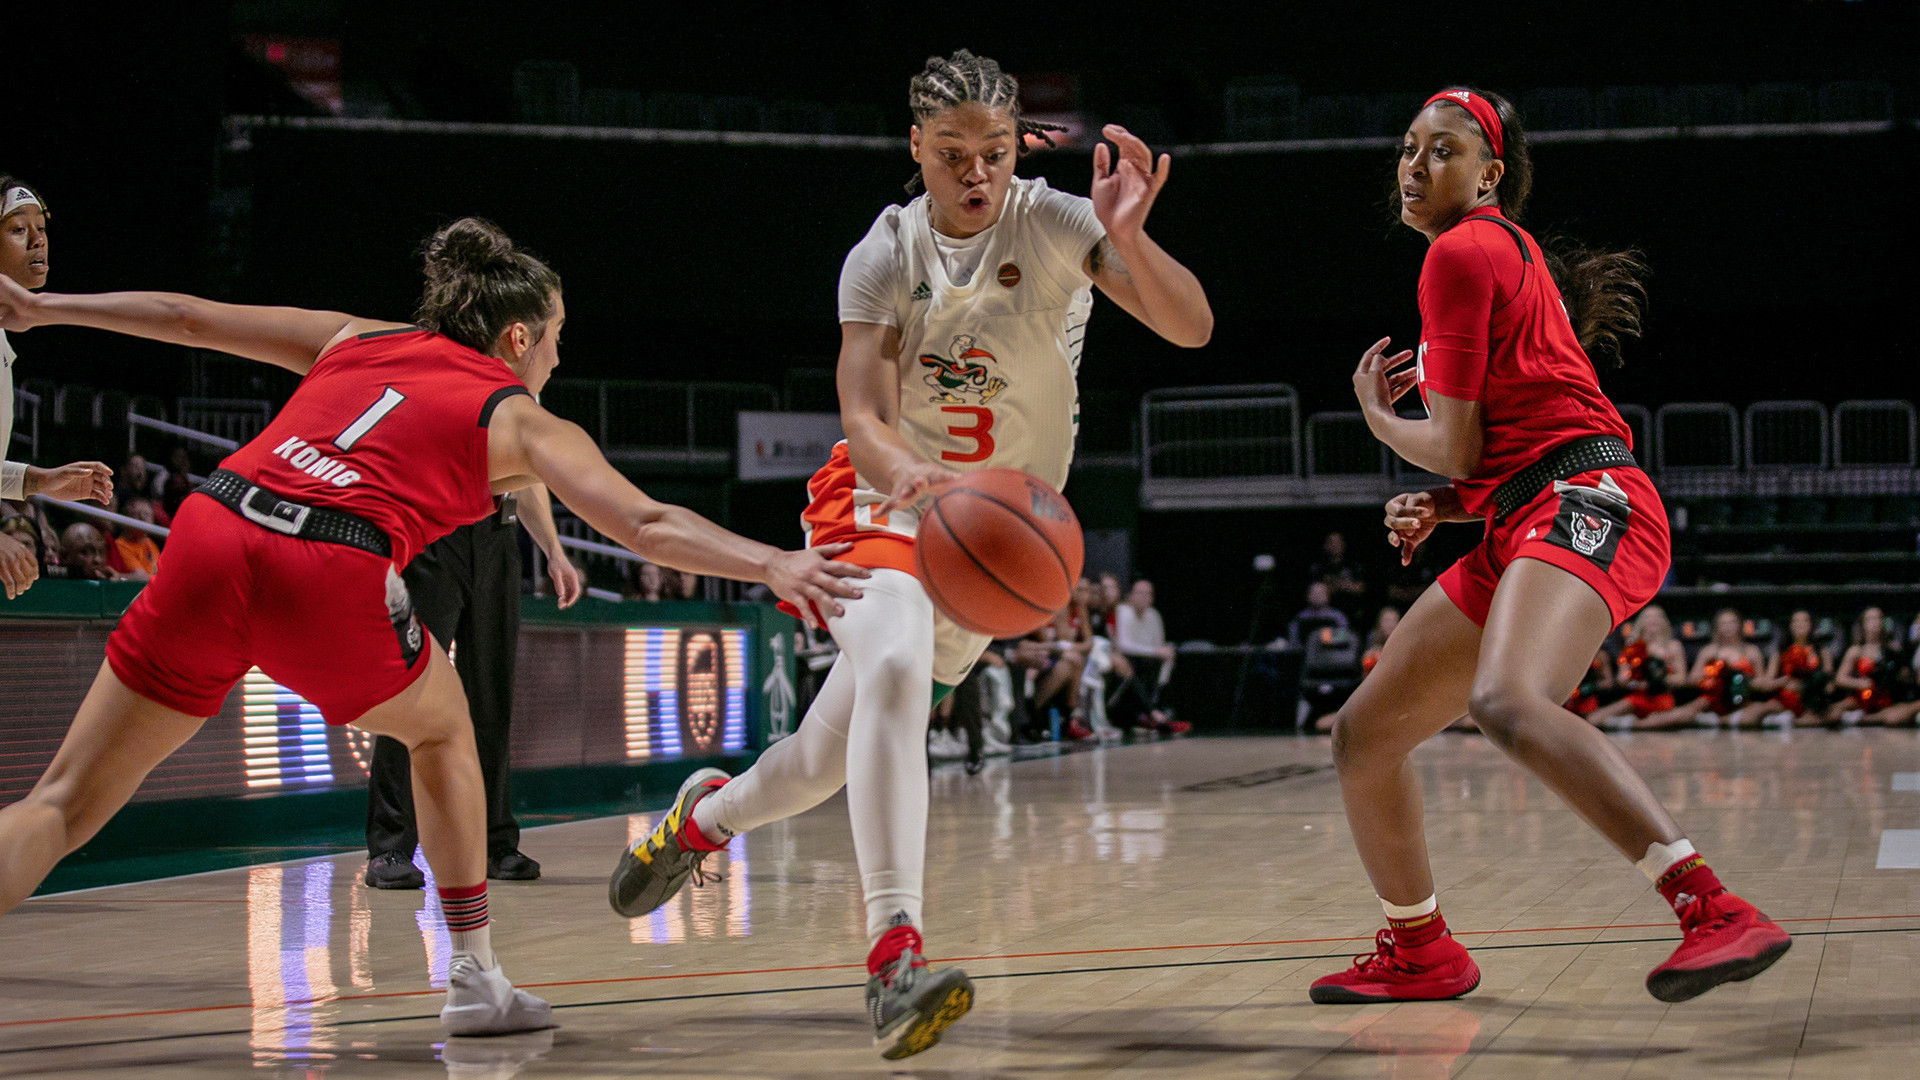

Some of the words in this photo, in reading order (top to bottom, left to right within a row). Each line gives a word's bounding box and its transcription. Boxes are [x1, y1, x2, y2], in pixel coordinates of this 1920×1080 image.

[331, 385, 406, 453] 1
[941, 406, 995, 463] 3
[272, 436, 361, 488] KONIG
